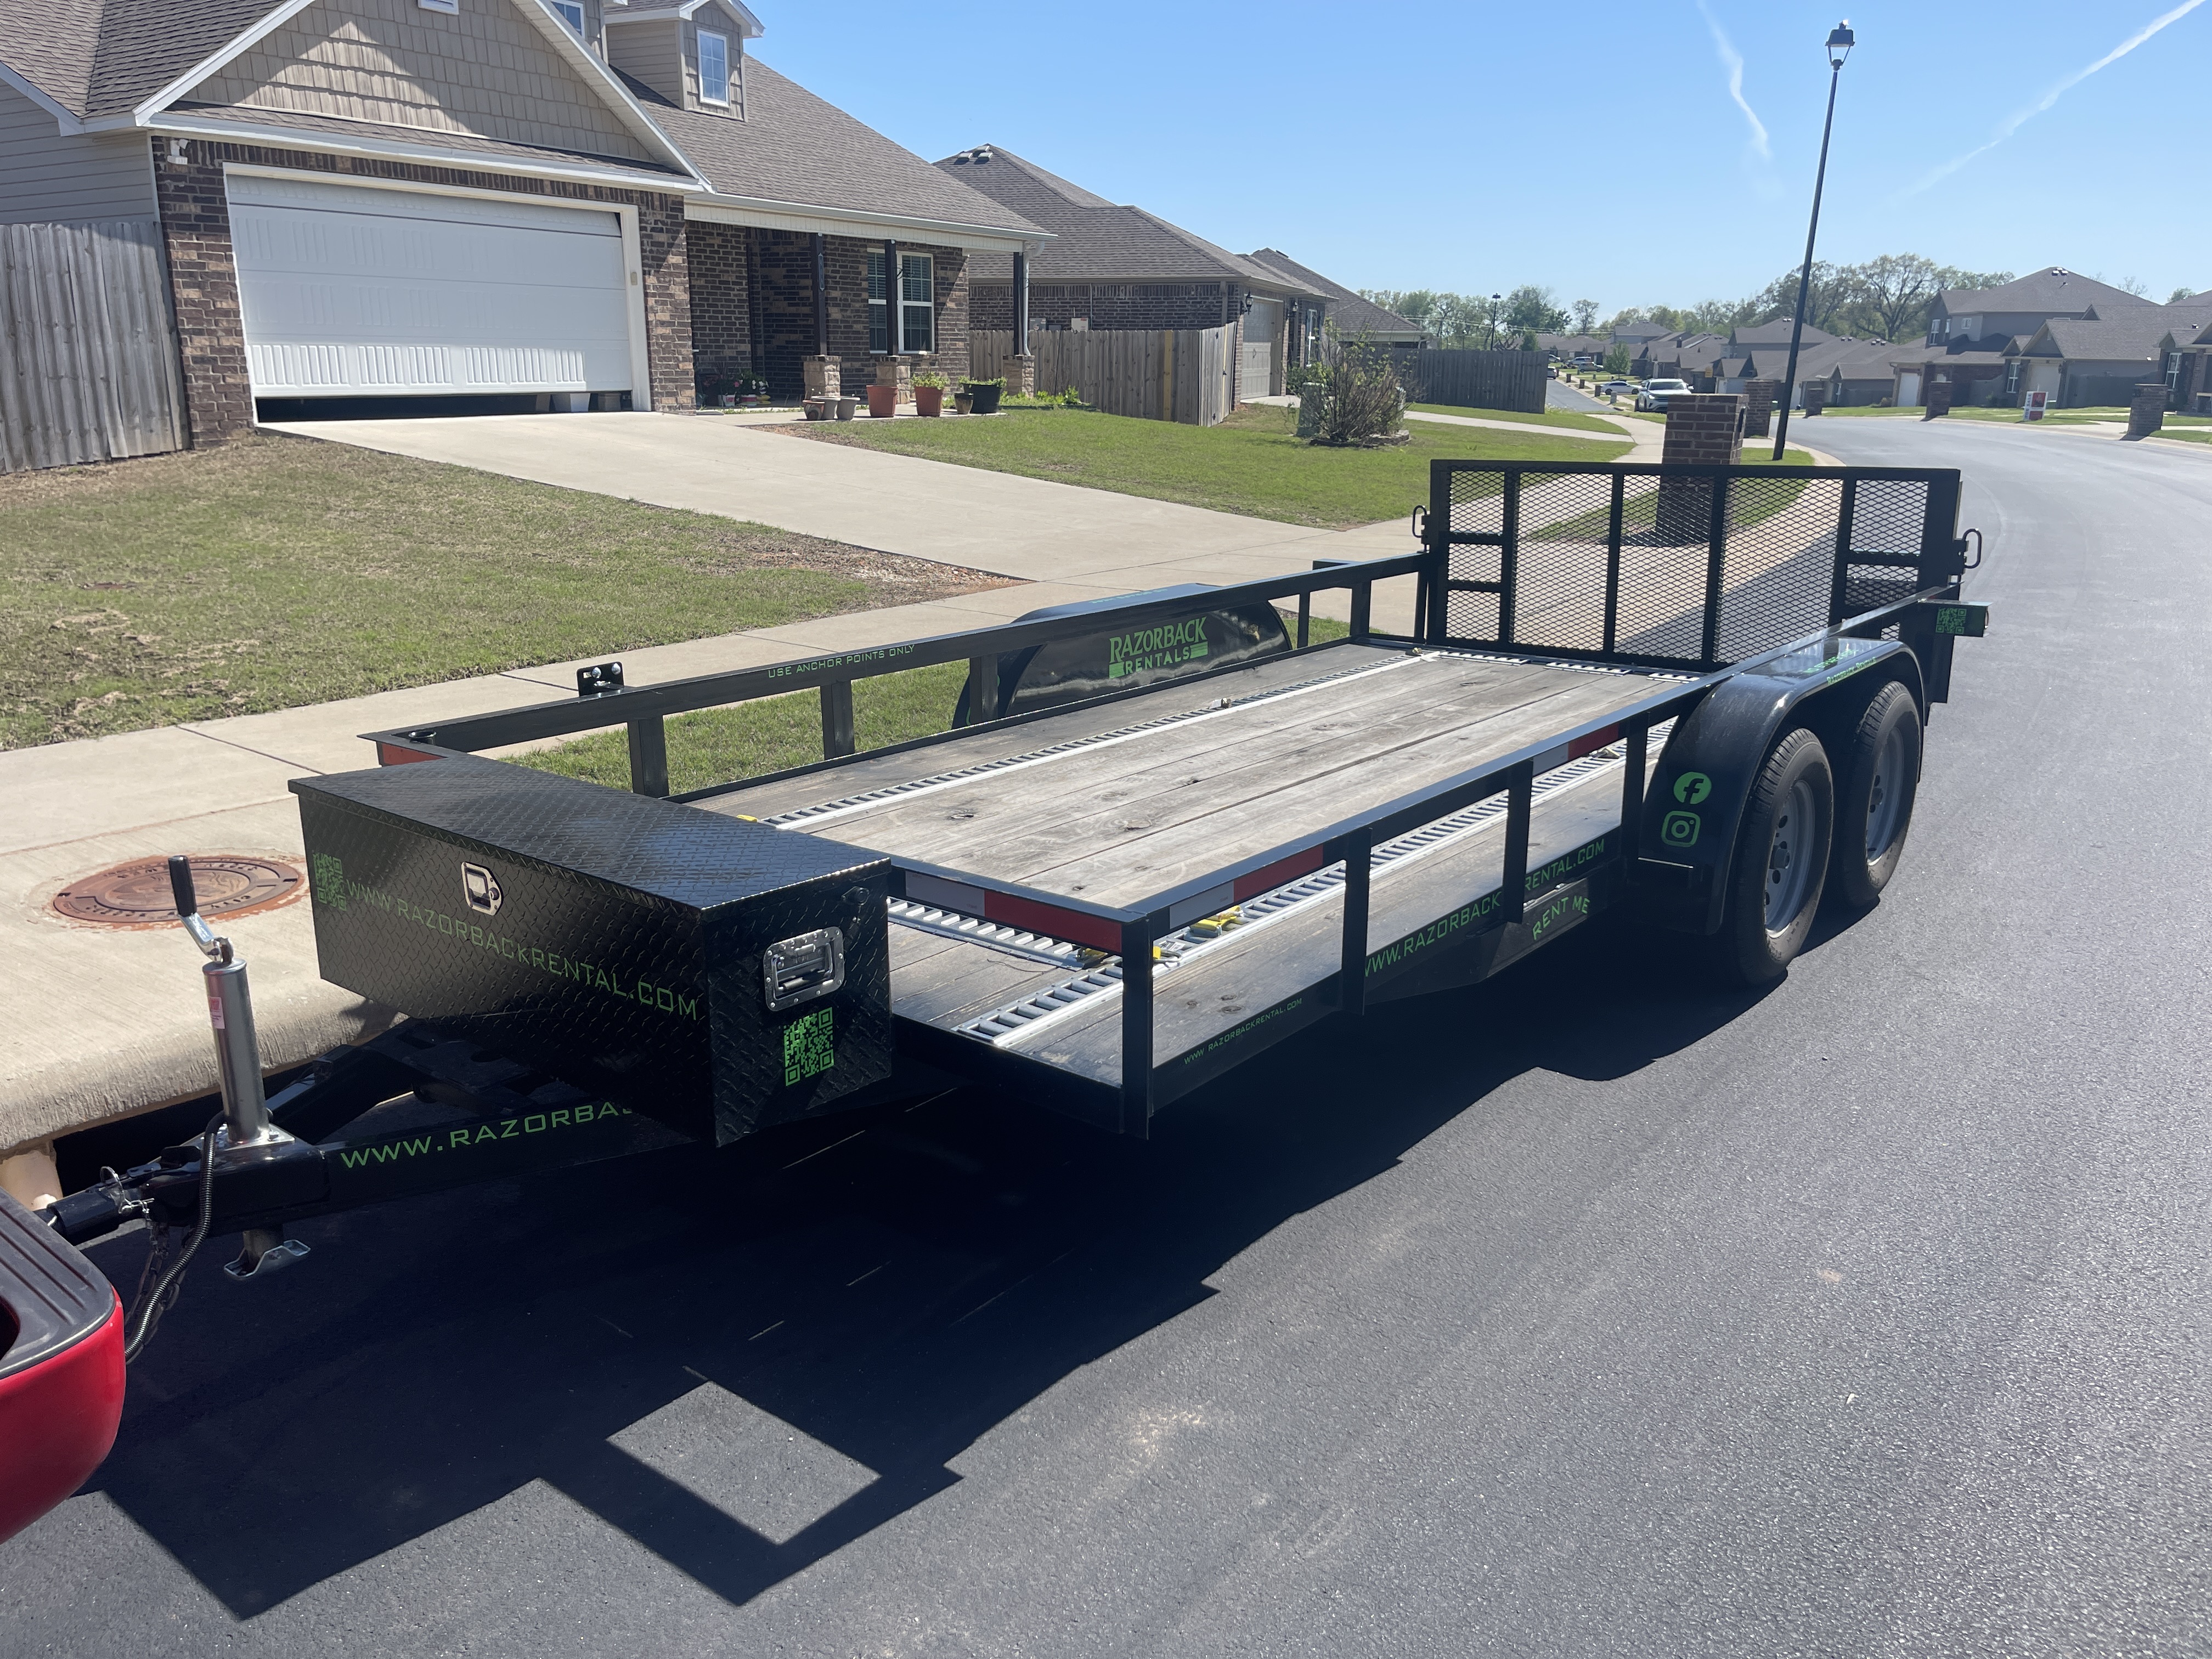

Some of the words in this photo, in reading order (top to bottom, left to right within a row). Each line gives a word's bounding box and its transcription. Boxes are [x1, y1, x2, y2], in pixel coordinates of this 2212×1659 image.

[769, 666, 792, 678] USE
[795, 657, 843, 674] ANCHOR
[847, 650, 885, 664] POINTS
[889, 644, 915, 657] ONLY
[1109, 616, 1207, 663] RAZORBACK
[1125, 646, 1190, 675] RENTALS
[1532, 896, 1569, 940] RENT
[1572, 895, 1590, 915] ME
[340, 1101, 633, 1168] WWW.RAZORBA
